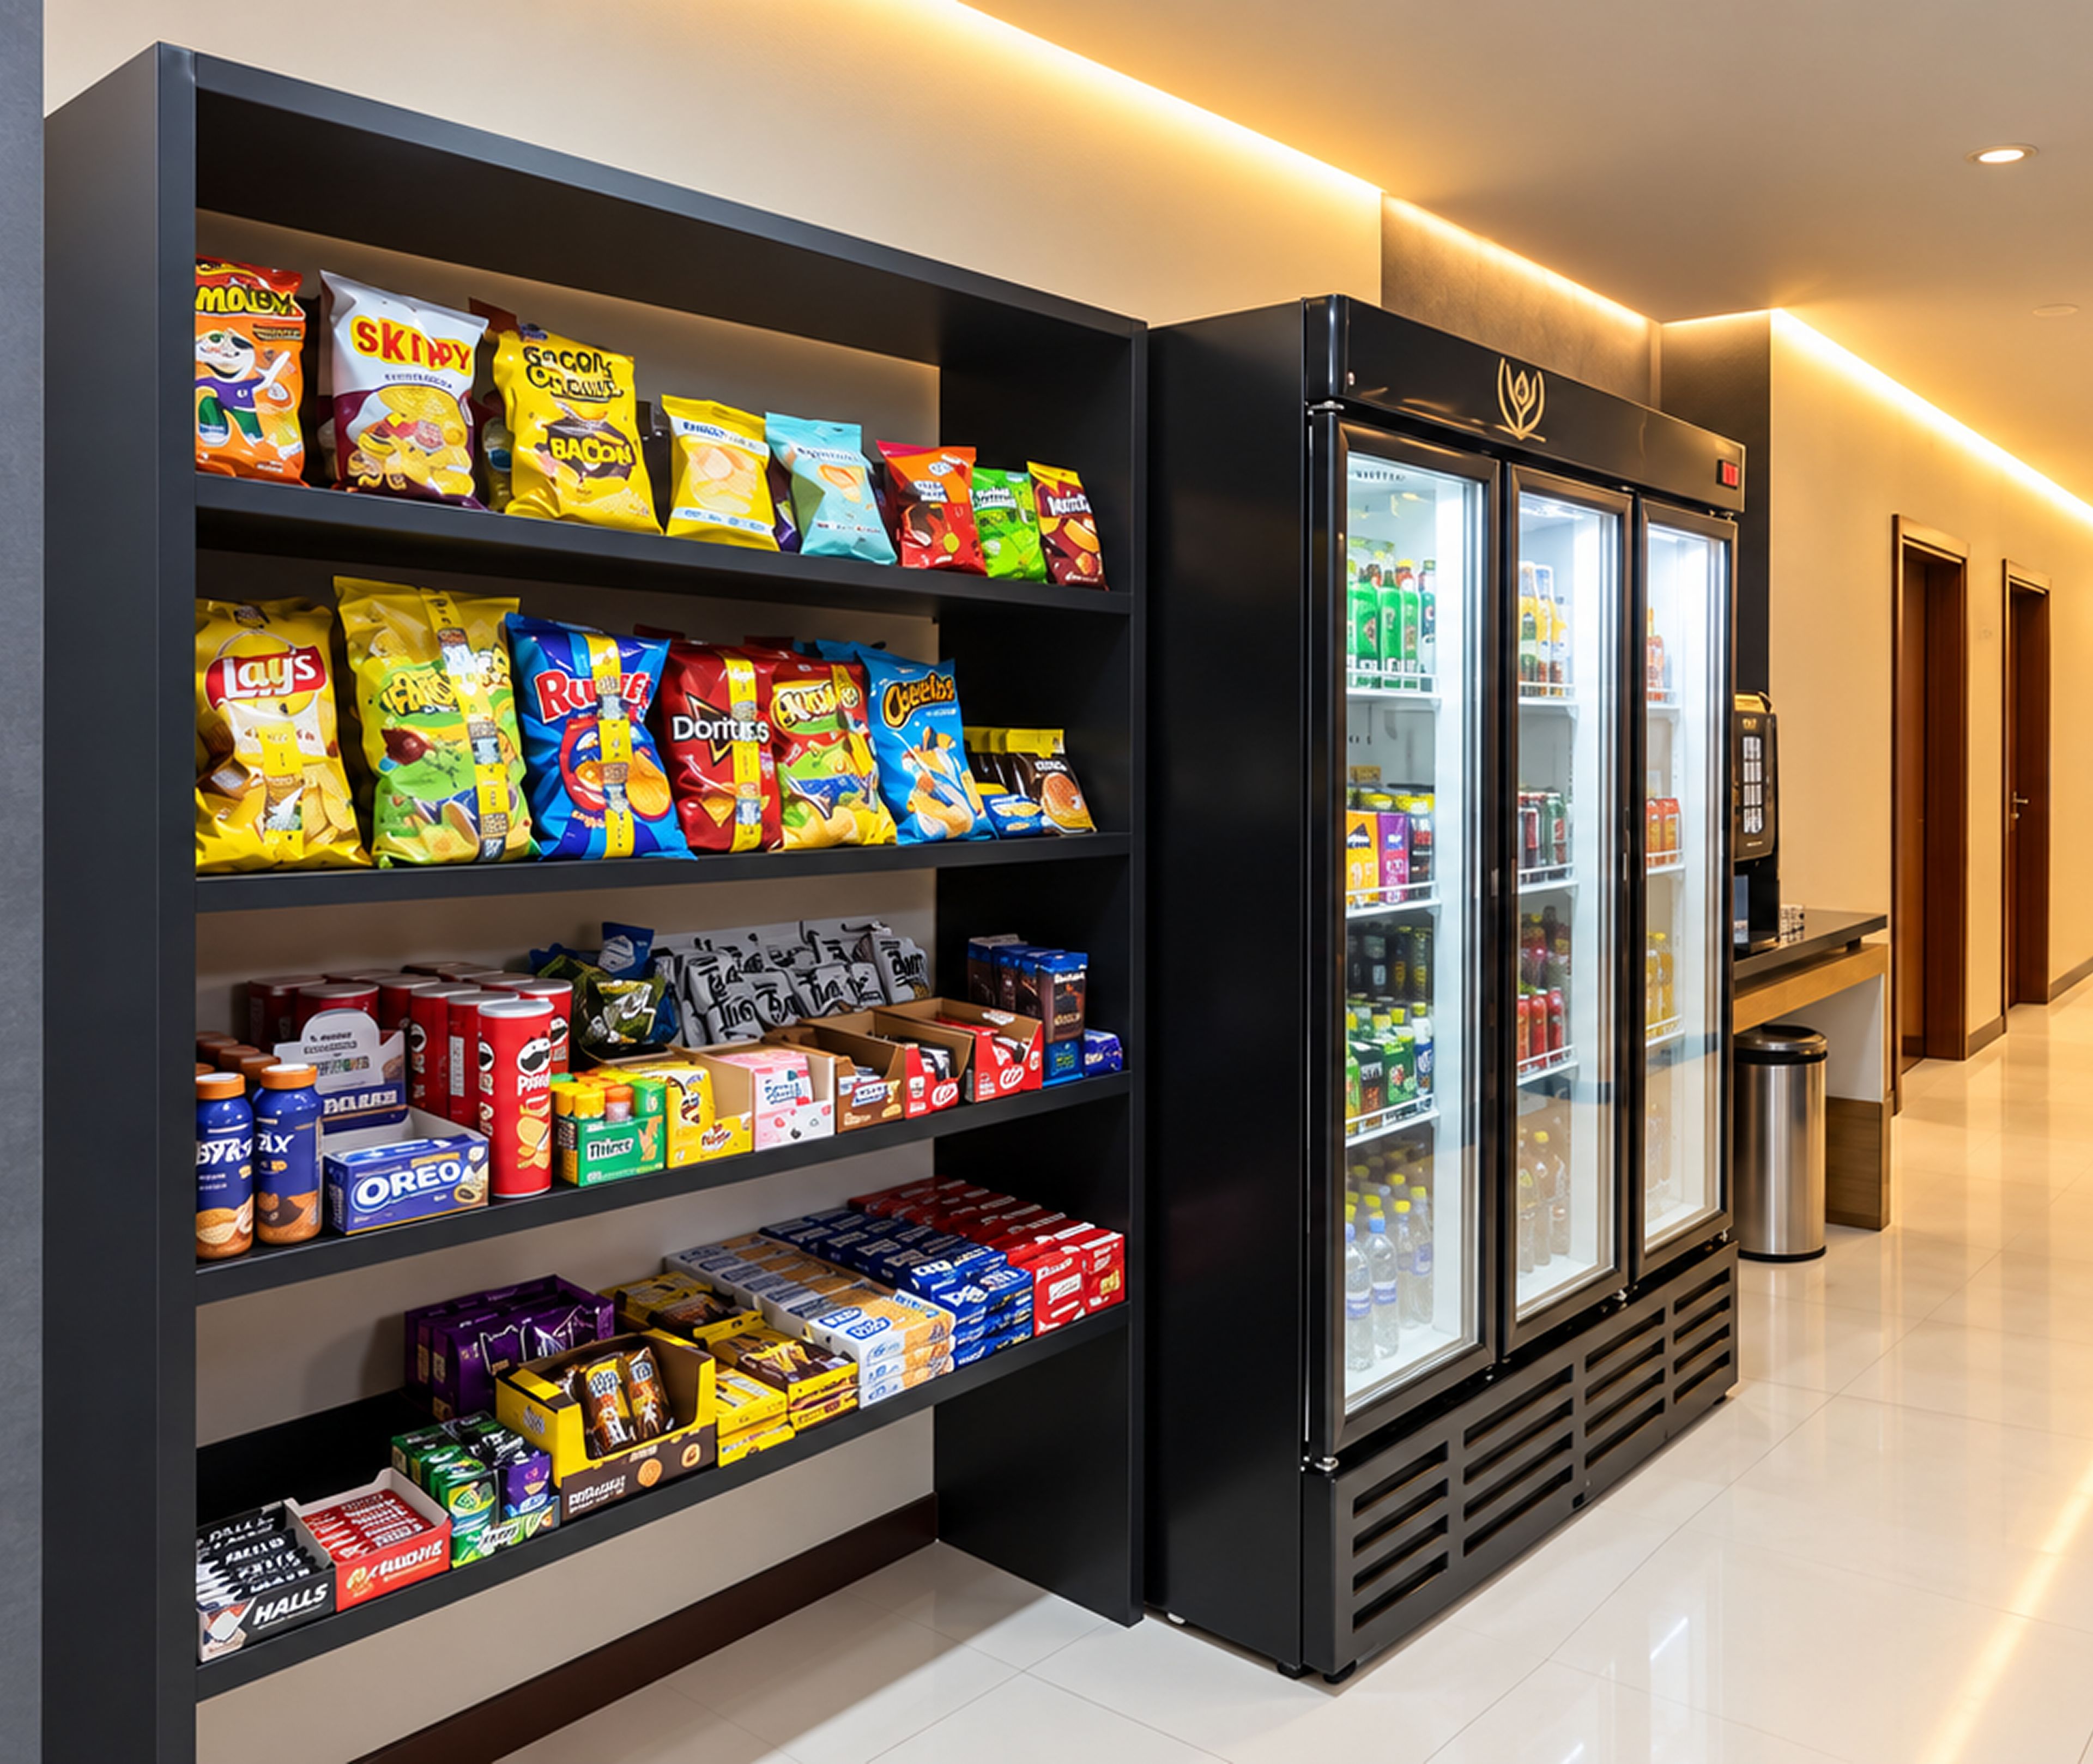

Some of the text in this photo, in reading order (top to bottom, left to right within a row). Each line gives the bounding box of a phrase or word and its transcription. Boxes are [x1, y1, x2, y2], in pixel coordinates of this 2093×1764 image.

[550, 437, 633, 466] BACON
[356, 1161, 461, 1205] OREO
[252, 1583, 329, 1630] HALLS
